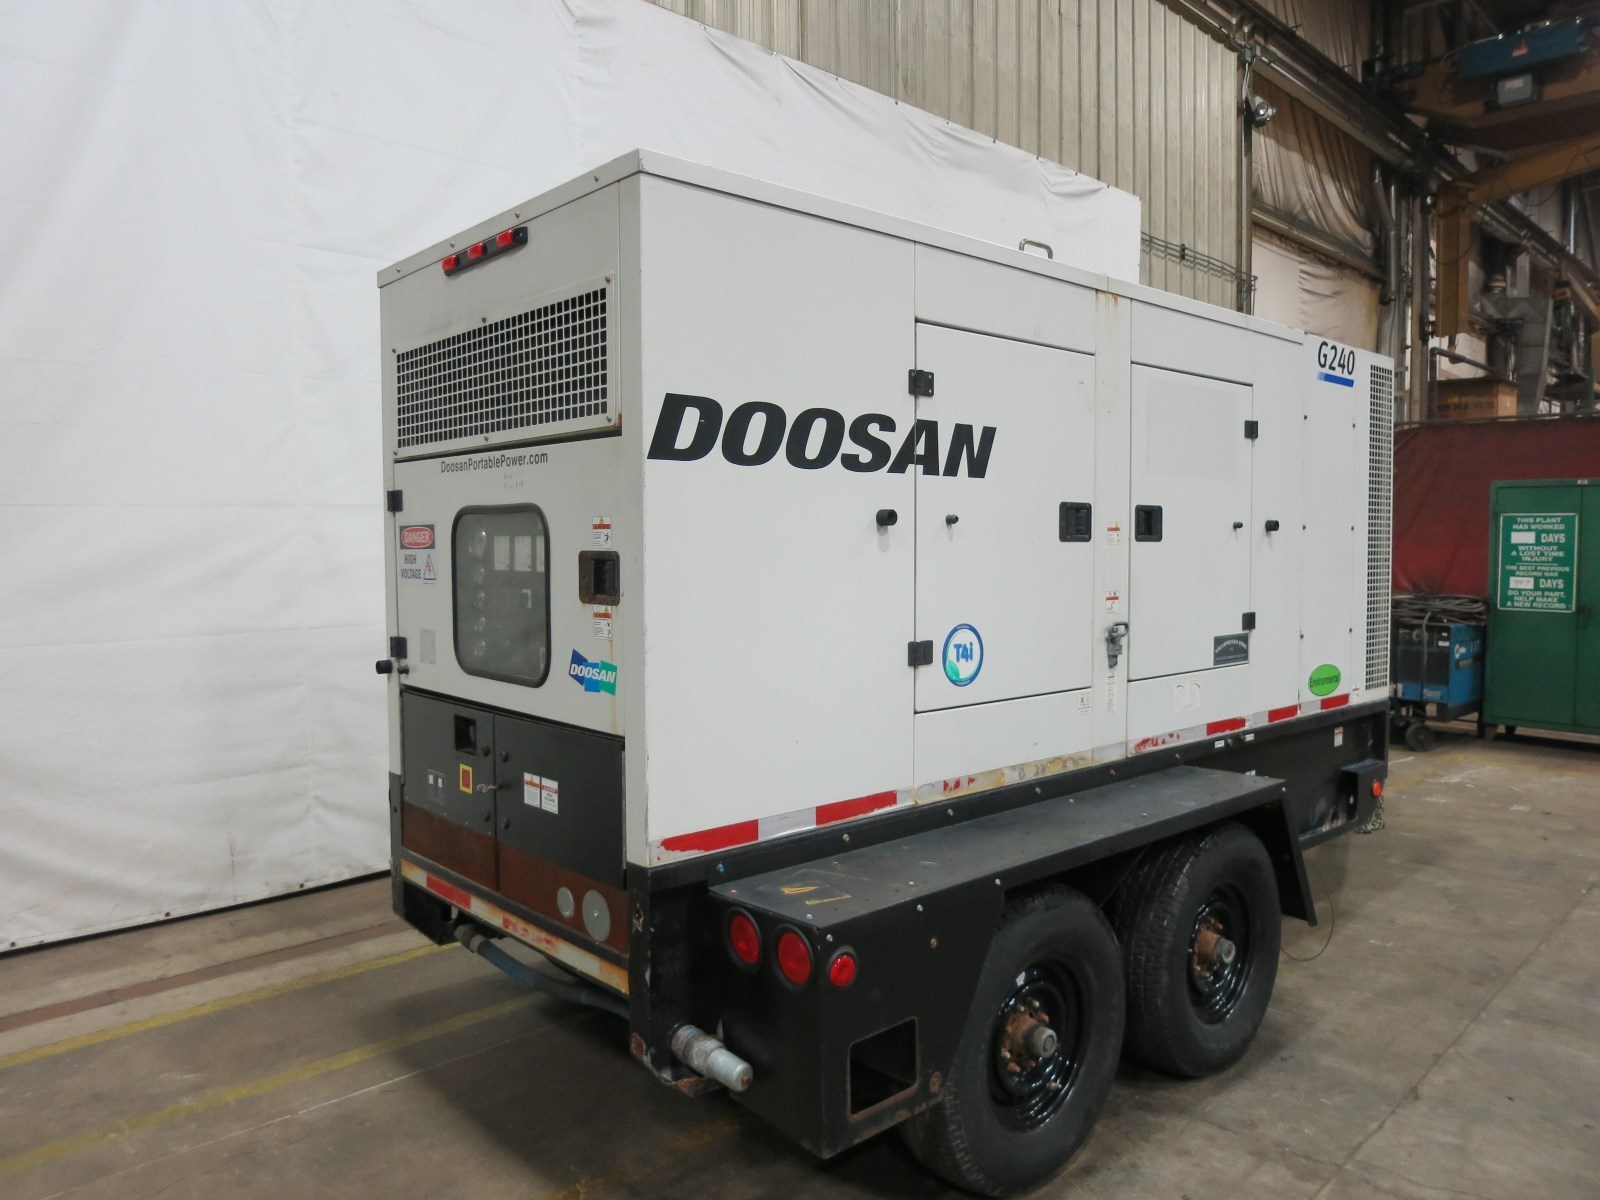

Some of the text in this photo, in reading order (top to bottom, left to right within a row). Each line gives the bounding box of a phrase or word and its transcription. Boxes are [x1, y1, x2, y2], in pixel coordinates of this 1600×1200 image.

[1318, 341, 1355, 375] G240
[646, 392, 997, 479] DOOSAN
[440, 453, 548, 473] DoosanPortablePower.com
[403, 531, 430, 543] DANGER
[1541, 533, 1566, 543] DAYS
[1539, 578, 1564, 589] DAYS
[953, 641, 973, 663] T4i
[570, 663, 617, 684] DOOSAN
